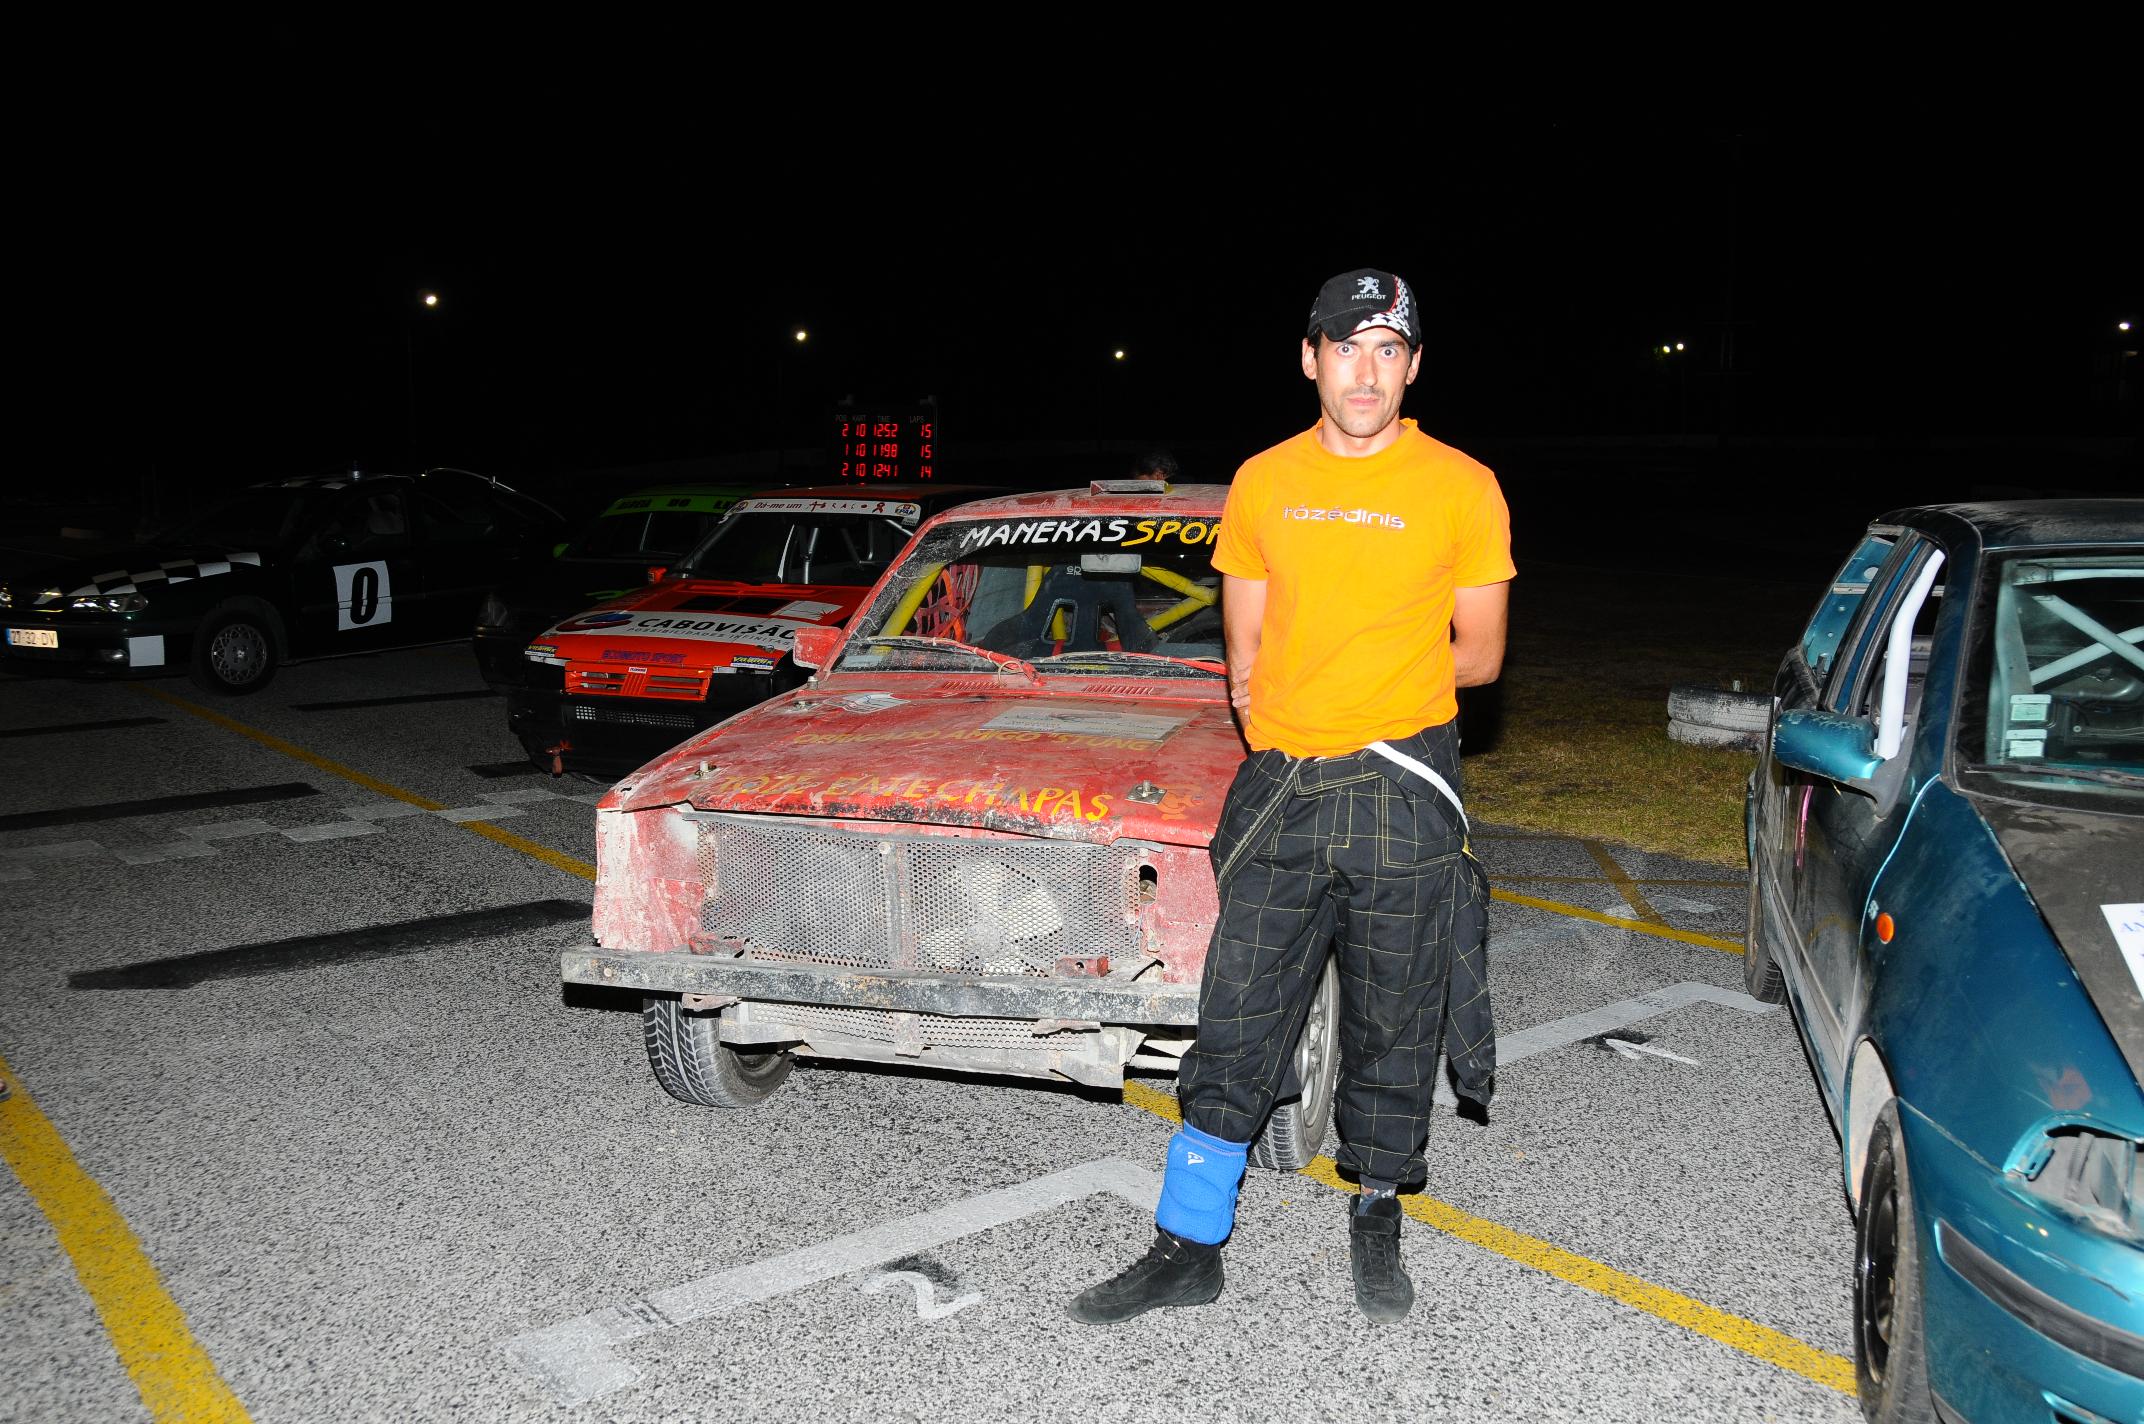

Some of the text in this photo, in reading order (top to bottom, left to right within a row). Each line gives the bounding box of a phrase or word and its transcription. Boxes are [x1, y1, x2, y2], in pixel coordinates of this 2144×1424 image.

[1351, 293, 1387, 301] PEUGEOT
[841, 423, 932, 438] 2 10 1252 15
[855, 443, 866, 457] 10
[920, 444, 932, 459] 15
[841, 462, 849, 476] 2
[855, 463, 866, 477] 10
[920, 464, 932, 479] 14
[960, 519, 1129, 548] MANEKAS
[350, 567, 378, 624] 0
[638, 618, 795, 640] CABOVISÃO
